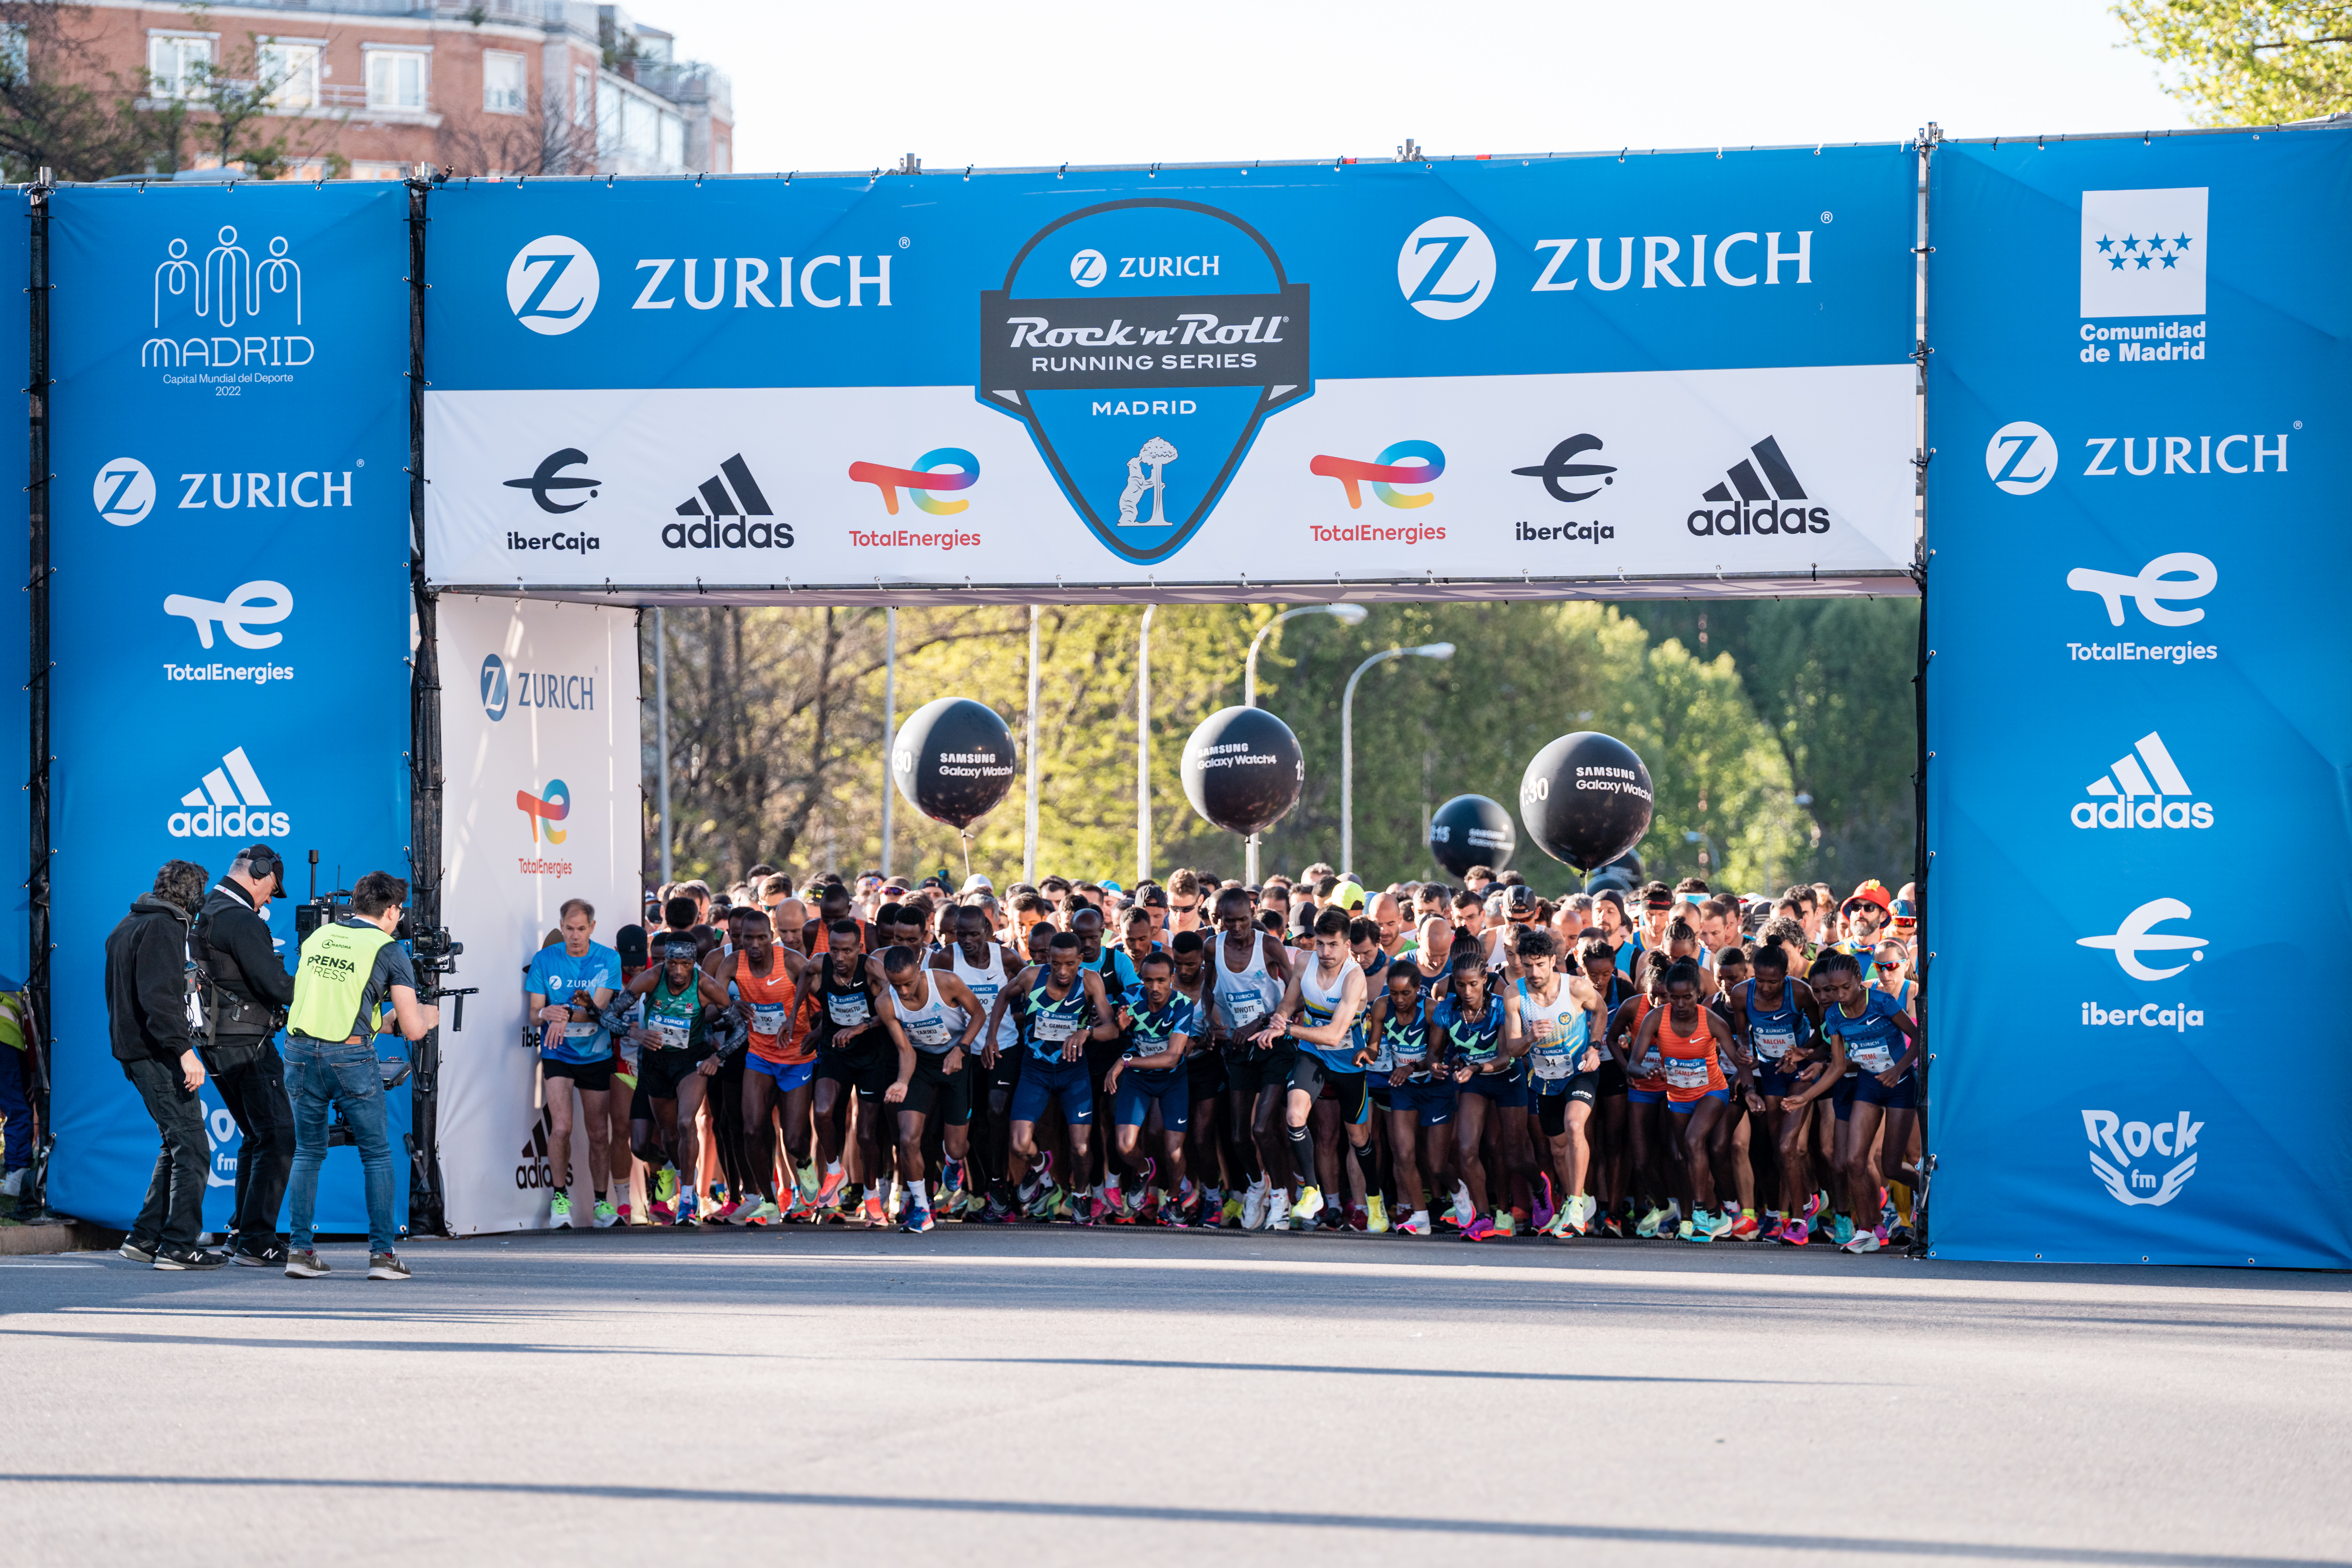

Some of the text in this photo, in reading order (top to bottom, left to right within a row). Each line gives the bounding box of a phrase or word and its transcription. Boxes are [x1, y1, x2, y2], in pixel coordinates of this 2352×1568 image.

[1119, 256, 1219, 278] ZURICH
[1531, 231, 1813, 291] ZURICH
[632, 255, 892, 310] ZURICH
[1007, 317, 1136, 348] Rock
[1176, 314, 1283, 345] Roll
[2081, 321, 2206, 342] Comunidad
[142, 336, 314, 367] MADRID
[1032, 353, 1257, 372] RUNNING SERIES
[2080, 341, 2205, 363] de Madrid
[163, 373, 294, 386] Capital Mundial del Deporte
[215, 386, 241, 396] 2022
[1092, 400, 1197, 416] MADRID
[2083, 434, 2288, 476] ZURICH
[178, 472, 352, 509] ZURICH
[1687, 500, 1830, 536] adidas
[507, 532, 600, 555] iberCaja
[661, 515, 795, 549] adidas
[849, 529, 981, 550] TotalEnergies
[1310, 522, 1446, 545] TotalEnergies
[1516, 520, 1614, 545] iberCaja
[2067, 641, 2217, 665] TotalEnergies
[163, 662, 294, 685] TotalEnergies
[518, 672, 594, 710] ZURICH
[940, 752, 996, 764] SAMSUNG
[1197, 743, 1249, 758] SAMSUNG
[939, 765, 982, 779] Galaxy
[1197, 755, 1277, 770] Galaxy Watch4
[1576, 766, 1635, 780] SAMSUNG
[1520, 777, 1549, 808] 1:30
[1576, 779, 1621, 794] Galaxy
[167, 805, 290, 837] adidas
[2071, 795, 2214, 829] adidas
[518, 858, 572, 879] TotalEnergies
[307, 955, 354, 973] PRENSA
[2082, 1002, 2204, 1033] iberCaja
[2081, 1109, 2205, 1166] Rock
[2131, 1169, 2156, 1188] fm
